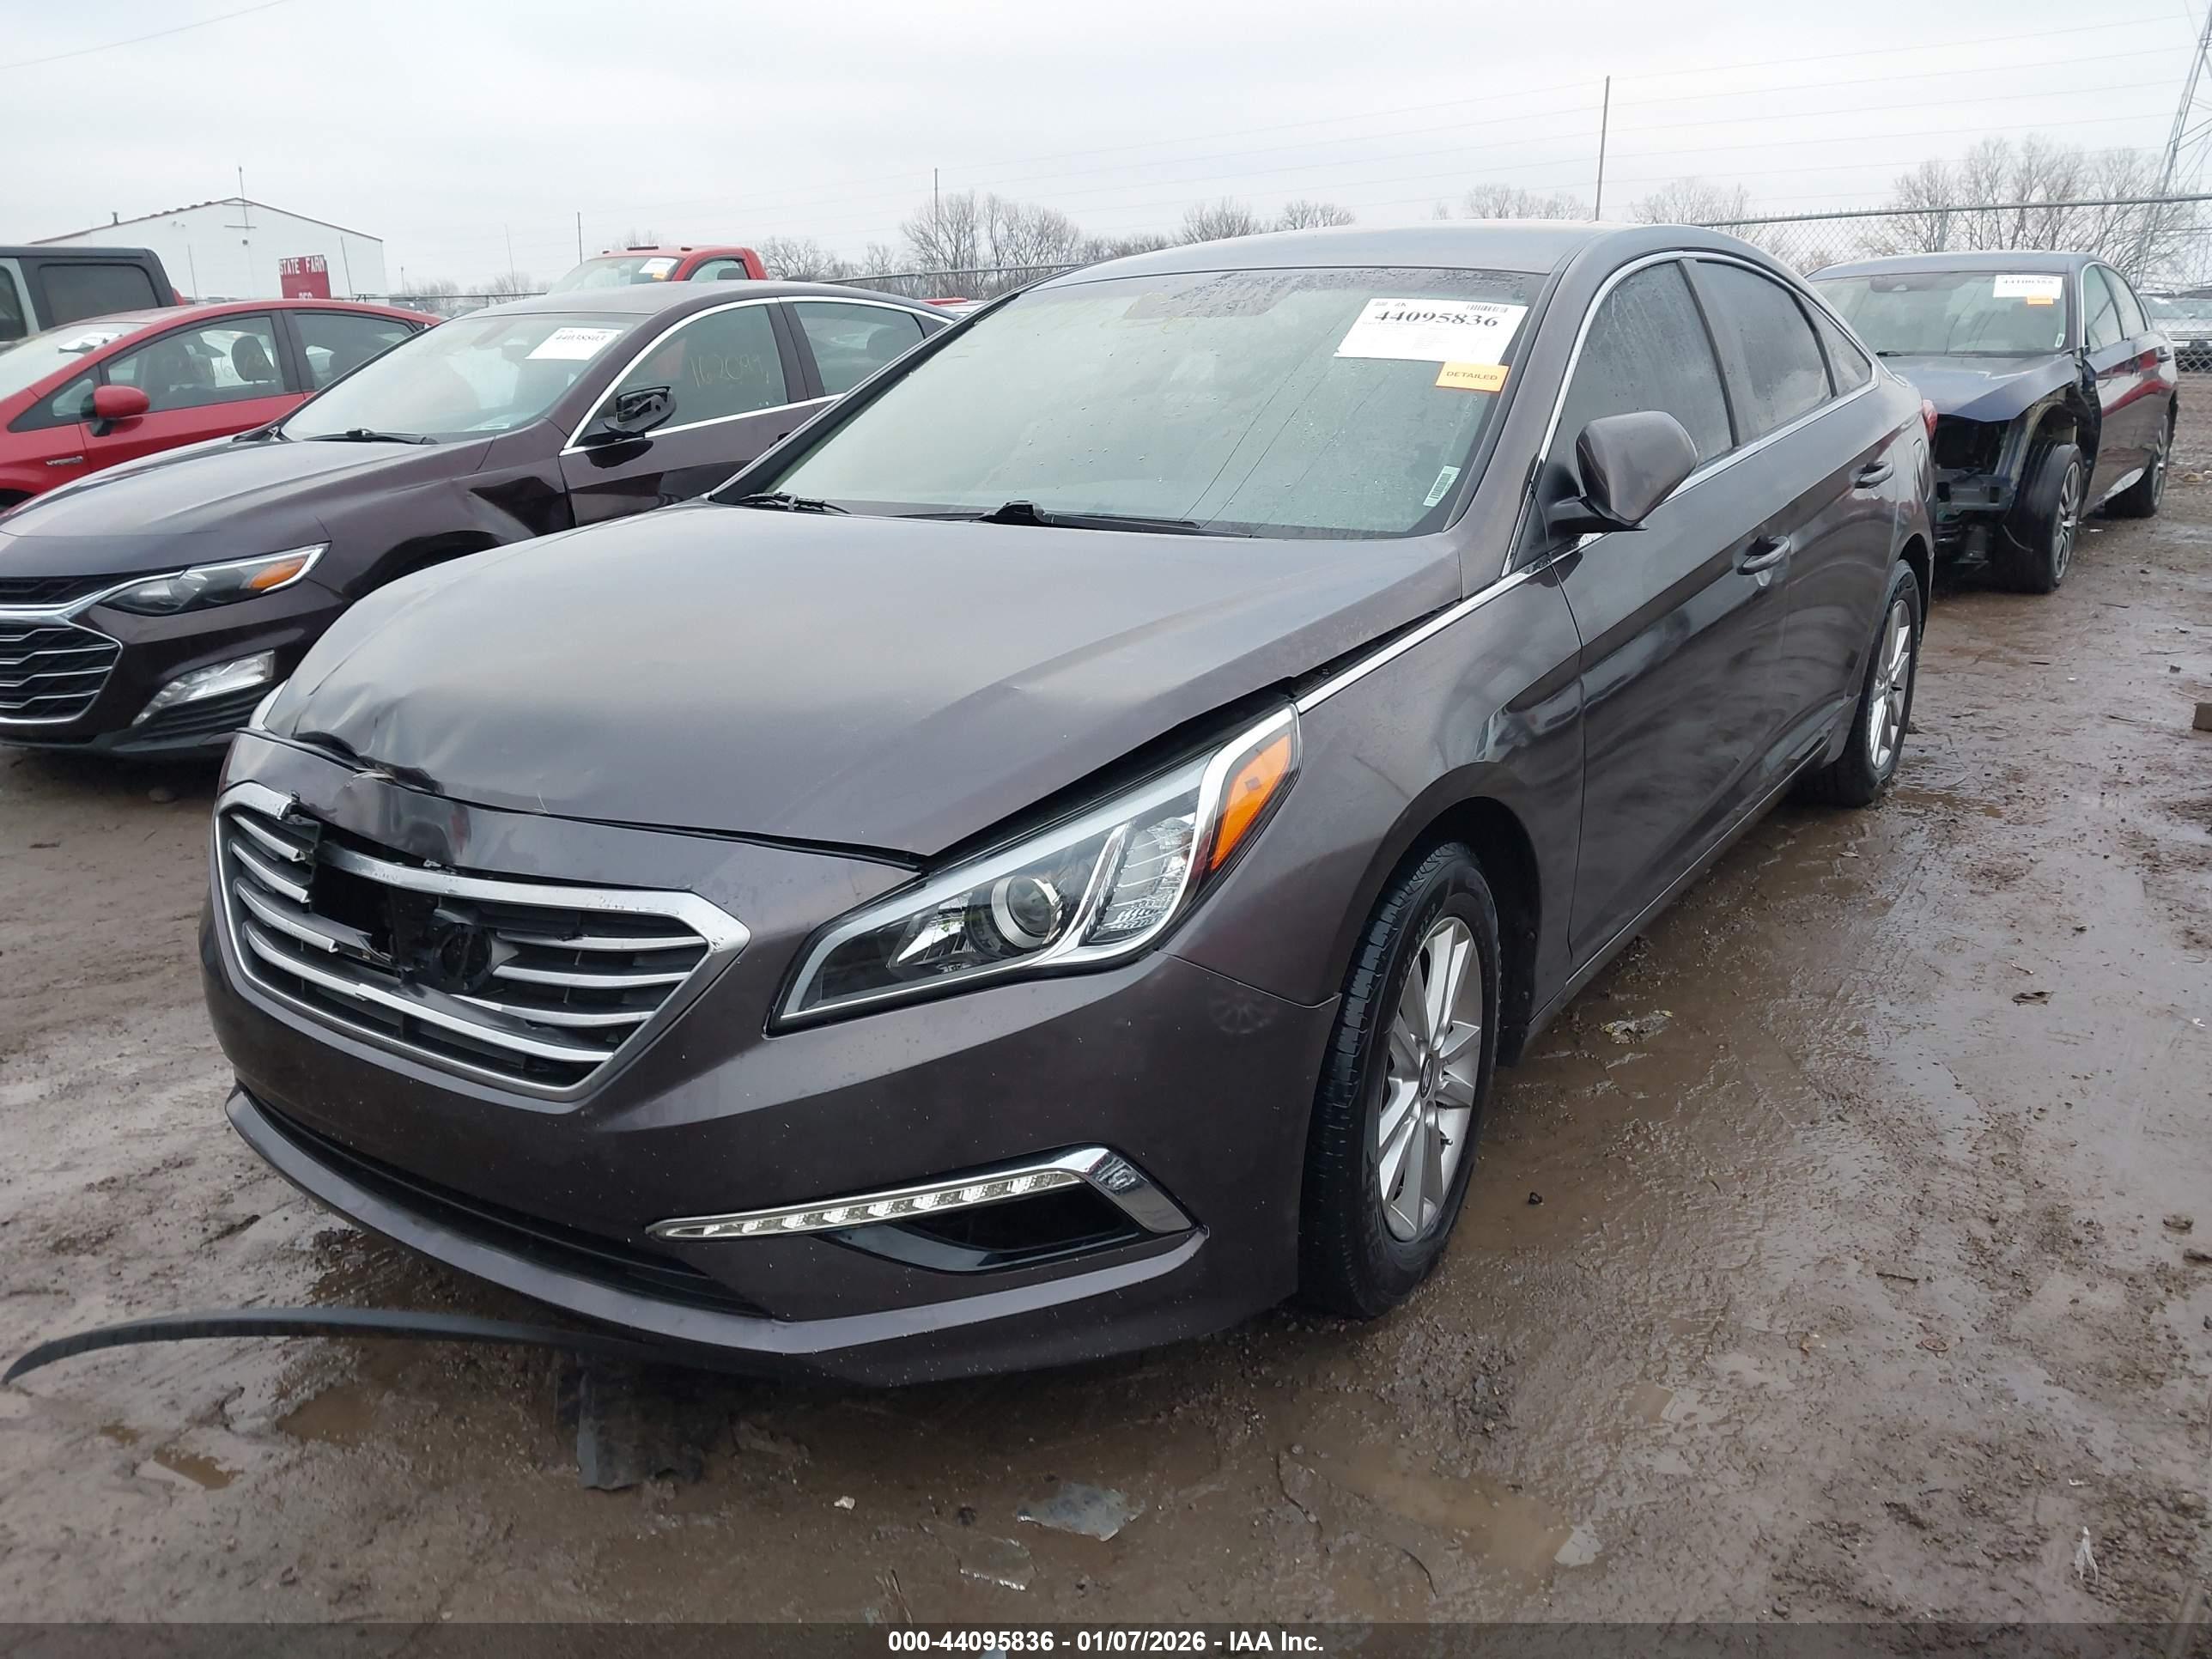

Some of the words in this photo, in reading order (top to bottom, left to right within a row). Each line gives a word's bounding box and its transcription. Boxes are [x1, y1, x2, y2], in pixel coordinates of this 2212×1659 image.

[279, 258, 300, 275] STATE
[1374, 311, 1499, 327] 44095836
[1445, 371, 1498, 381] DETAILED
